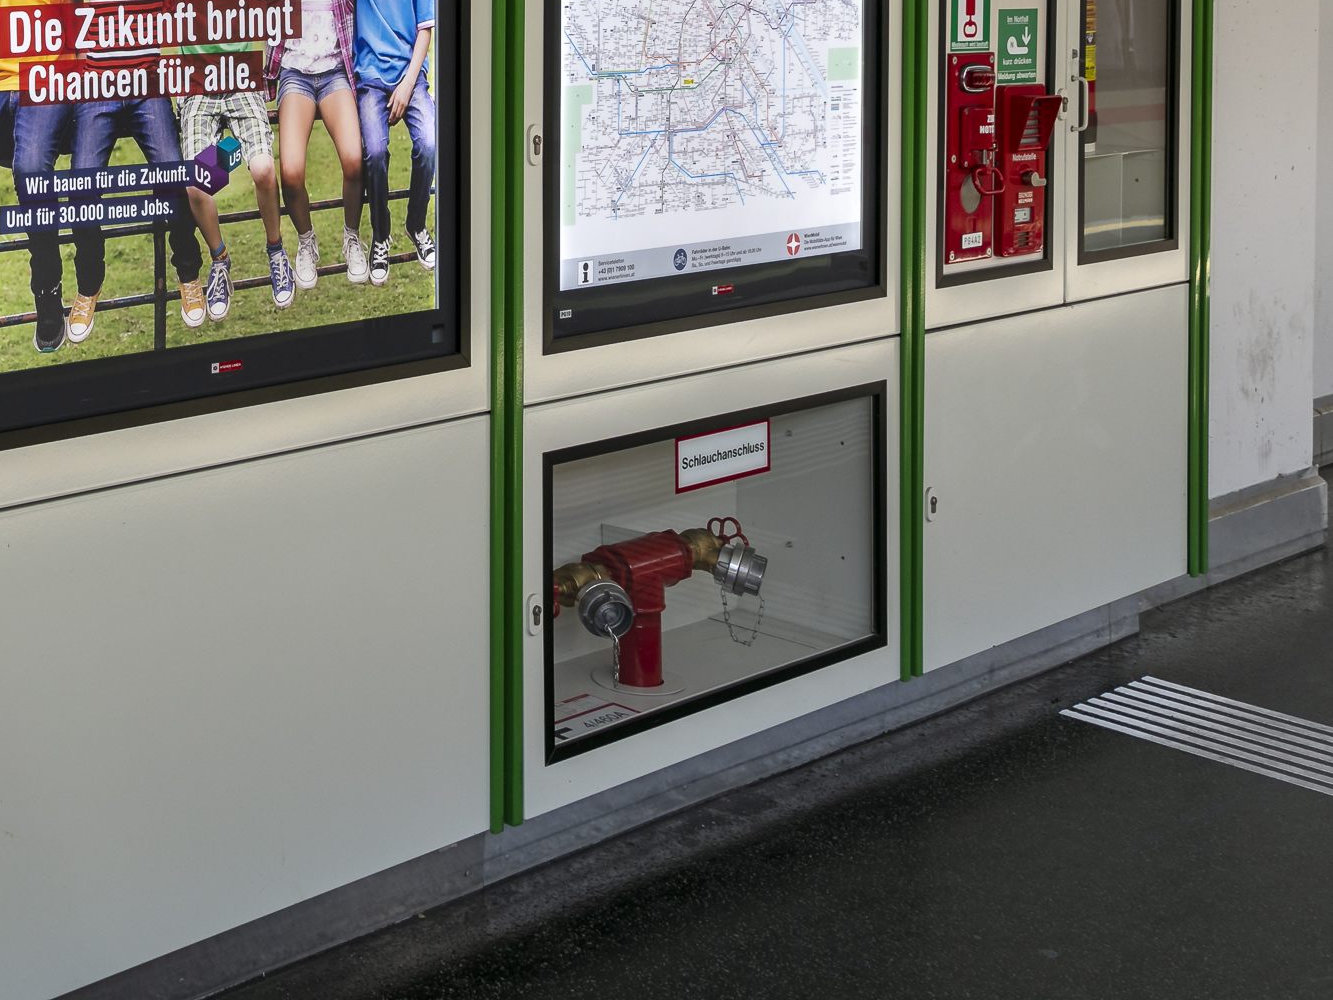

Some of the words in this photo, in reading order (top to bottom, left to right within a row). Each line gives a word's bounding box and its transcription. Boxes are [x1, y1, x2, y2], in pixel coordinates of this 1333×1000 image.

[9, 9, 62, 54] Die
[75, 2, 197, 50] Zukunft
[1014, 15, 1029, 23] Notfall
[28, 64, 148, 103] Chancen
[157, 58, 195, 94] für
[204, 55, 256, 92] alle.
[229, 149, 242, 167] U5
[26, 175, 50, 195] Wir
[53, 173, 92, 192] bauen
[96, 171, 114, 189] für
[117, 169, 136, 187] die
[140, 165, 190, 186] Zukunft.
[194, 164, 212, 189] U2
[6, 208, 32, 228] Und
[36, 206, 56, 225] für
[59, 203, 104, 224] 30.000
[108, 203, 138, 219] neue
[141, 199, 173, 217] Jobs.
[682, 442, 765, 470] Schlauchanschluss
